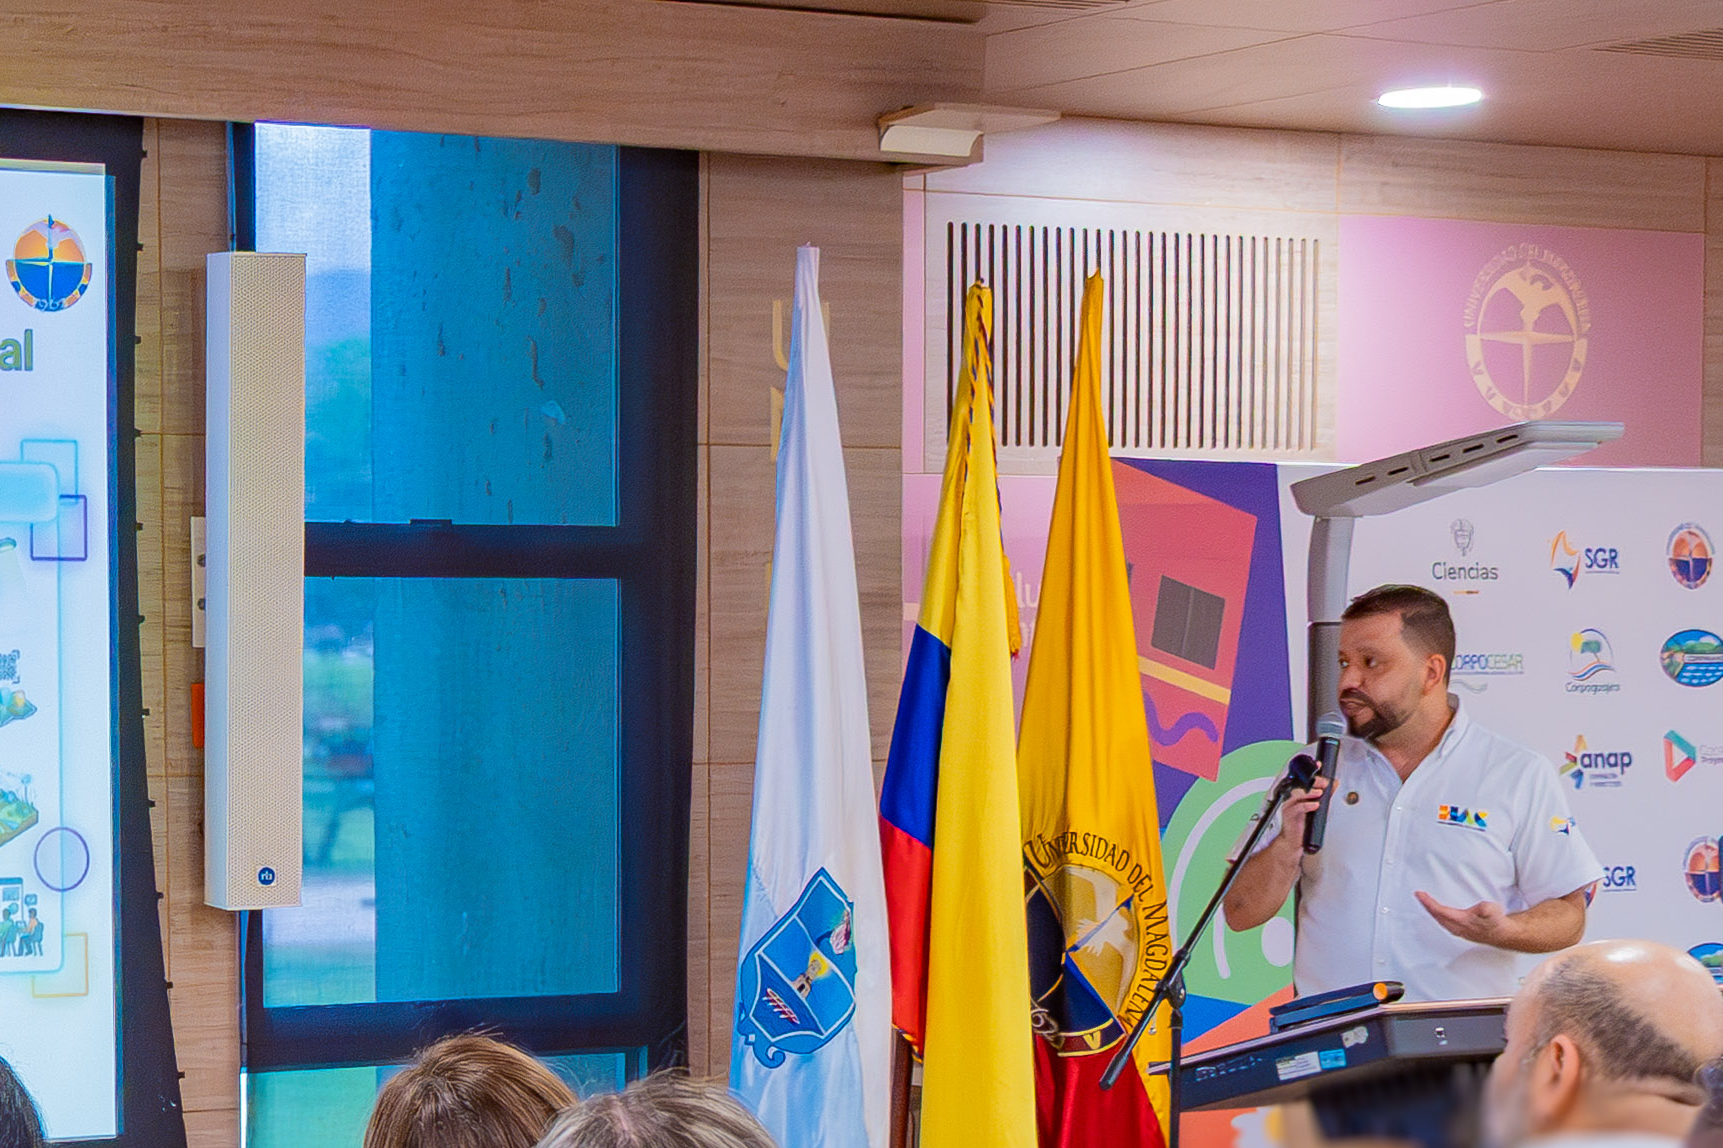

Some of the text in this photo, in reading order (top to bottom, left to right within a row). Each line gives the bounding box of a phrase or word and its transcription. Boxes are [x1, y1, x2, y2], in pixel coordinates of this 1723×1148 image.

[1585, 548, 1619, 569] SGR
[1432, 562, 1499, 580] Ciencias
[1581, 752, 1632, 776] anap
[1024, 831, 1130, 871] UNERSIDAD
[1127, 863, 1154, 902] DEL
